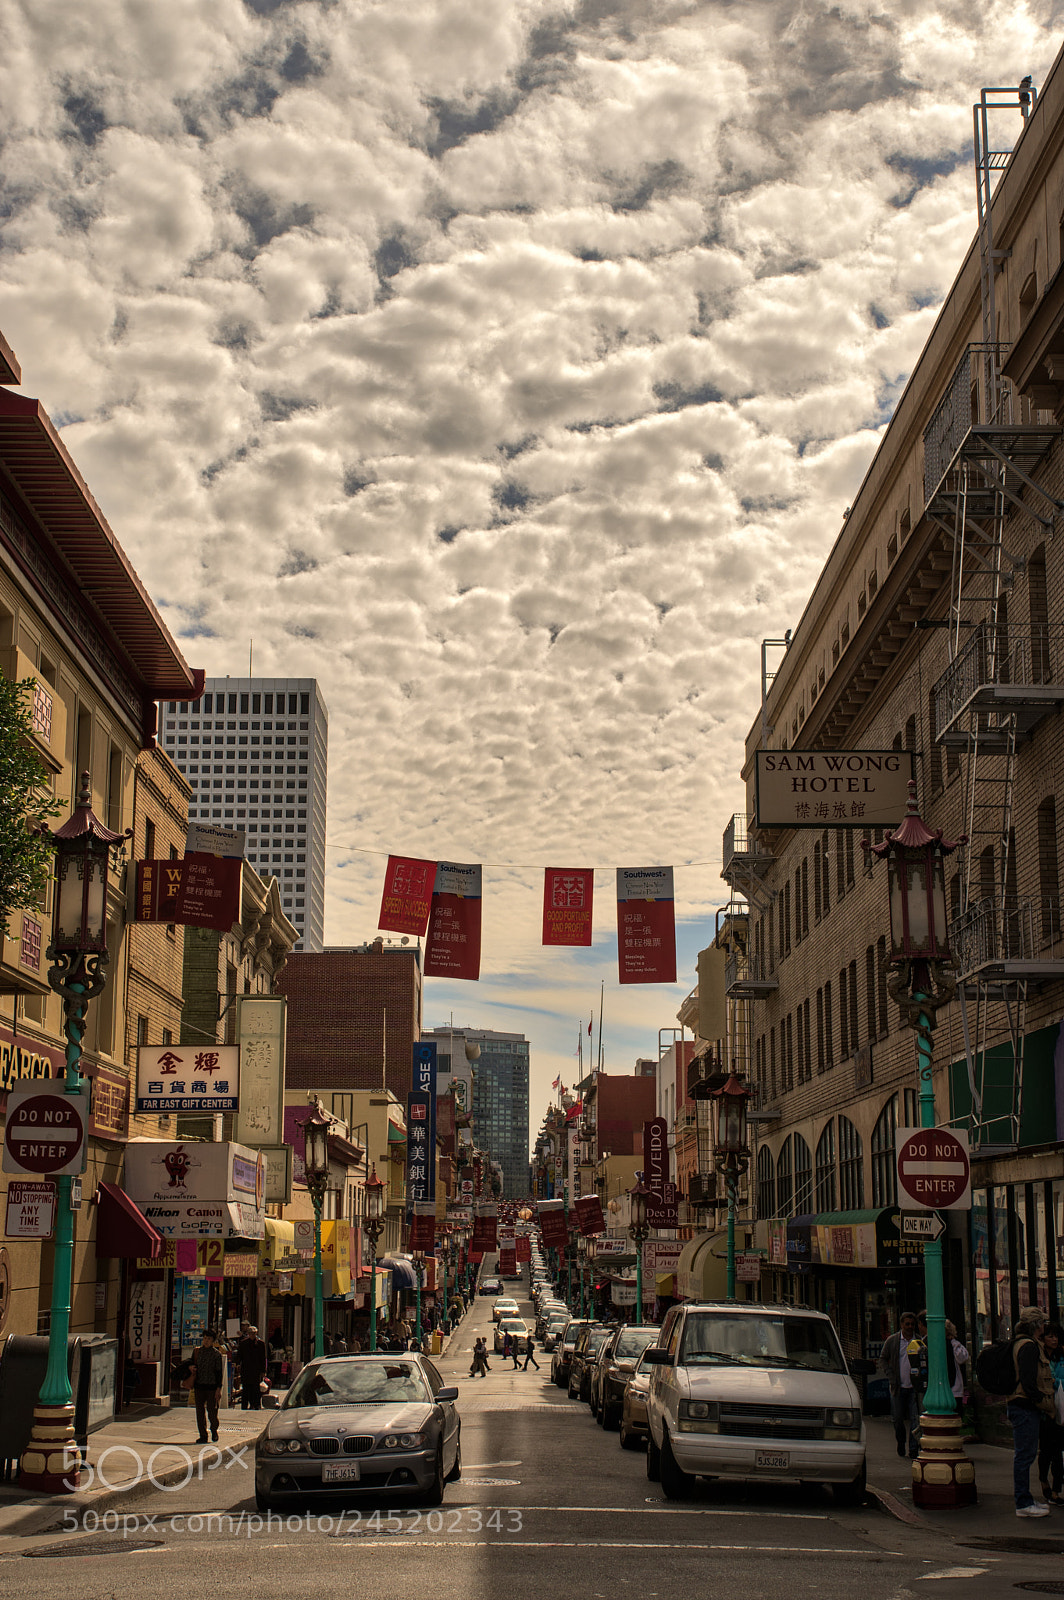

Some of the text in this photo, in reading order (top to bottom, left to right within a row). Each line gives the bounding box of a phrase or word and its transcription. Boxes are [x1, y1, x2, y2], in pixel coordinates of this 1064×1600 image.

[766, 755, 900, 771] SAM WONG
[791, 777, 876, 792] HOTEL
[195, 826, 234, 839] Southwest
[440, 864, 472, 875] Southwest
[624, 870, 663, 878] Southwest
[547, 910, 590, 922] GOOD FORTUNE
[552, 922, 584, 933] AND PROFIT
[157, 1052, 220, 1076] 金輝
[148, 1080, 229, 1094] 百貨商場
[143, 1098, 233, 1109] FAR EAST GIFT CENTER
[19, 1109, 72, 1123] DO NOT
[19, 1144, 67, 1158] ENTER
[909, 1144, 959, 1157] DO NOT
[409, 1126, 426, 1199] 華美銀行
[916, 1179, 956, 1192] ENTER
[9, 1191, 52, 1204] NO STOPPING
[21, 1206, 39, 1215] ANY
[145, 1207, 222, 1217] Nikon Canon
[646, 1208, 663, 1218] Dee
[20, 1216, 39, 1226] TIME
[905, 1219, 932, 1232] ONE WAY
[657, 1243, 674, 1251] Dee
[133, 1300, 145, 1347] zippo
[152, 1306, 161, 1337] SALE
[325, 1469, 356, 1479] 7HEJ615
